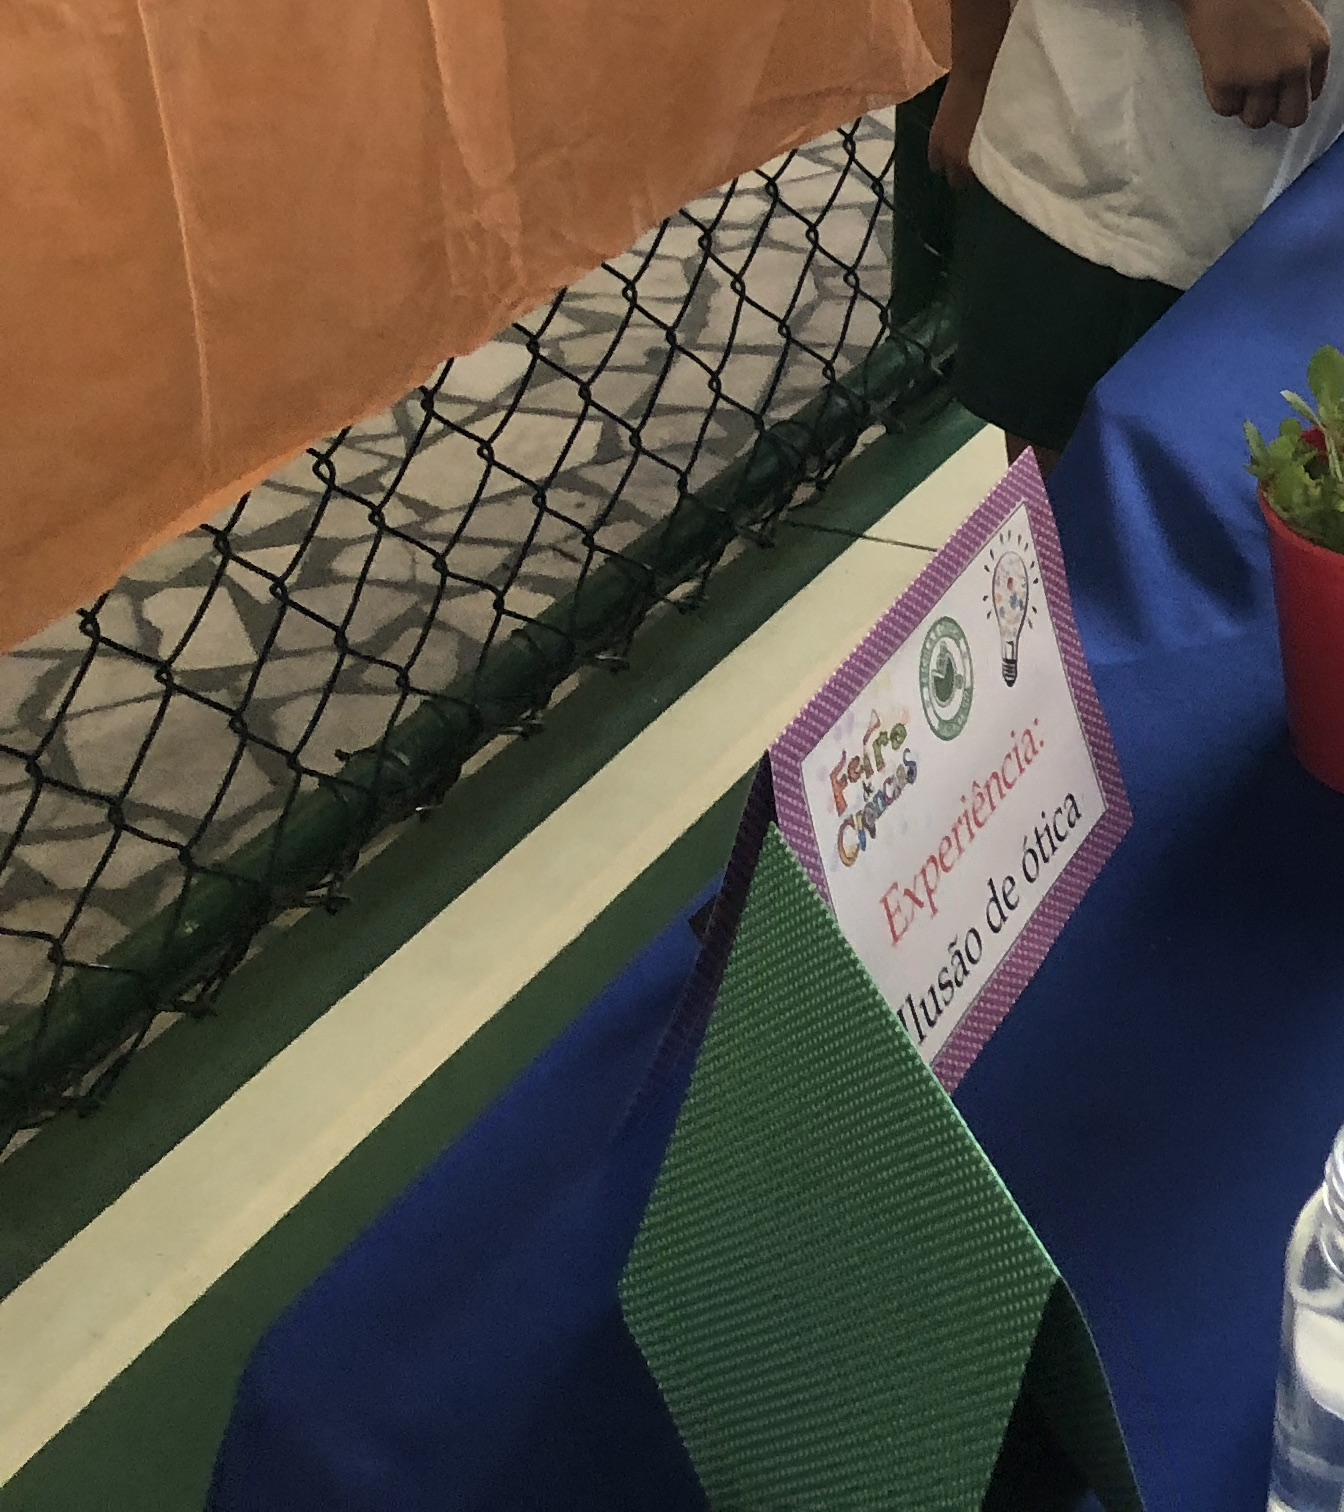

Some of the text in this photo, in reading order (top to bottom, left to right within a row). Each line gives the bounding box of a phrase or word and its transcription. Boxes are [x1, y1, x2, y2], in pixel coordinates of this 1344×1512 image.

[878, 717, 1047, 947] Experiência:
[985, 872, 1020, 937] de
[1021, 791, 1083, 885] ótica
